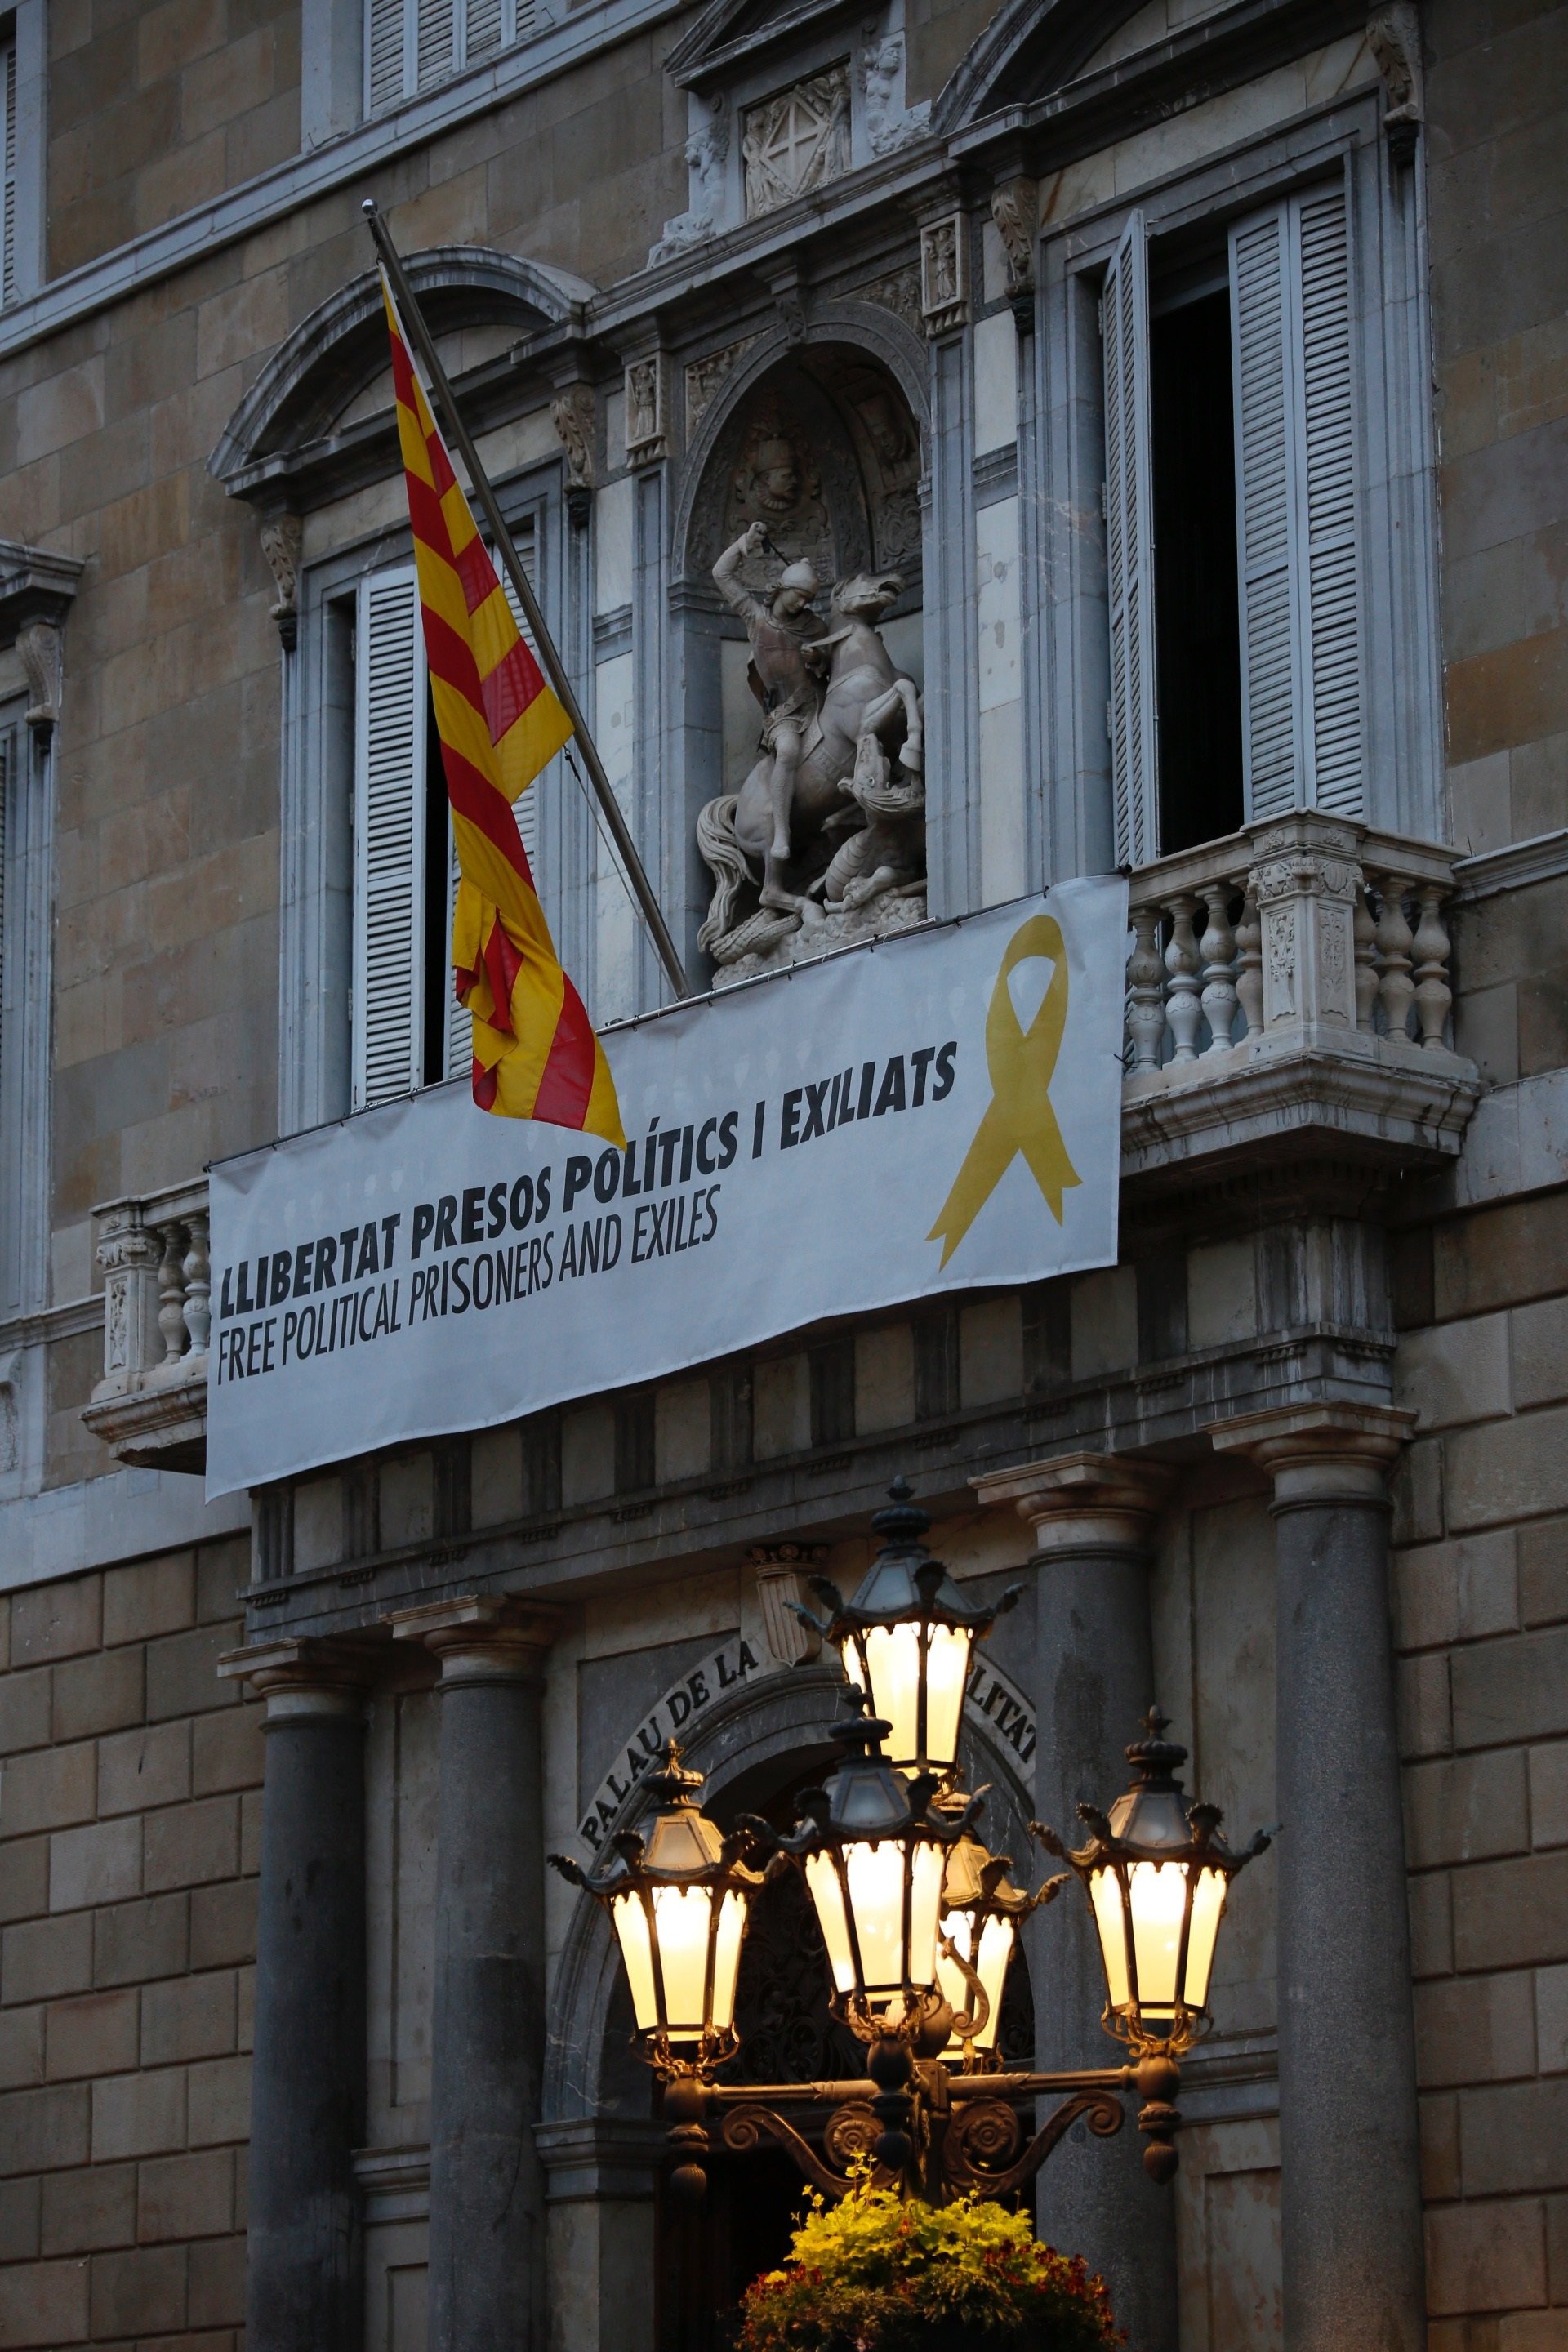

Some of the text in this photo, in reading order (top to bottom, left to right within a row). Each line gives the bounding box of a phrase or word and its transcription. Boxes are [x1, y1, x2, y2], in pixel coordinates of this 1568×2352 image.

[217, 1184, 721, 1386] FREE POLITICAL PRISONERS AND EXILES
[220, 1041, 958, 1320] LLIBERTAT PRESOS POLÍTICS I EXILIATS
[581, 1717, 662, 1851] PALAU
[666, 1670, 710, 1728] DE
[714, 1641, 759, 1688] LA
